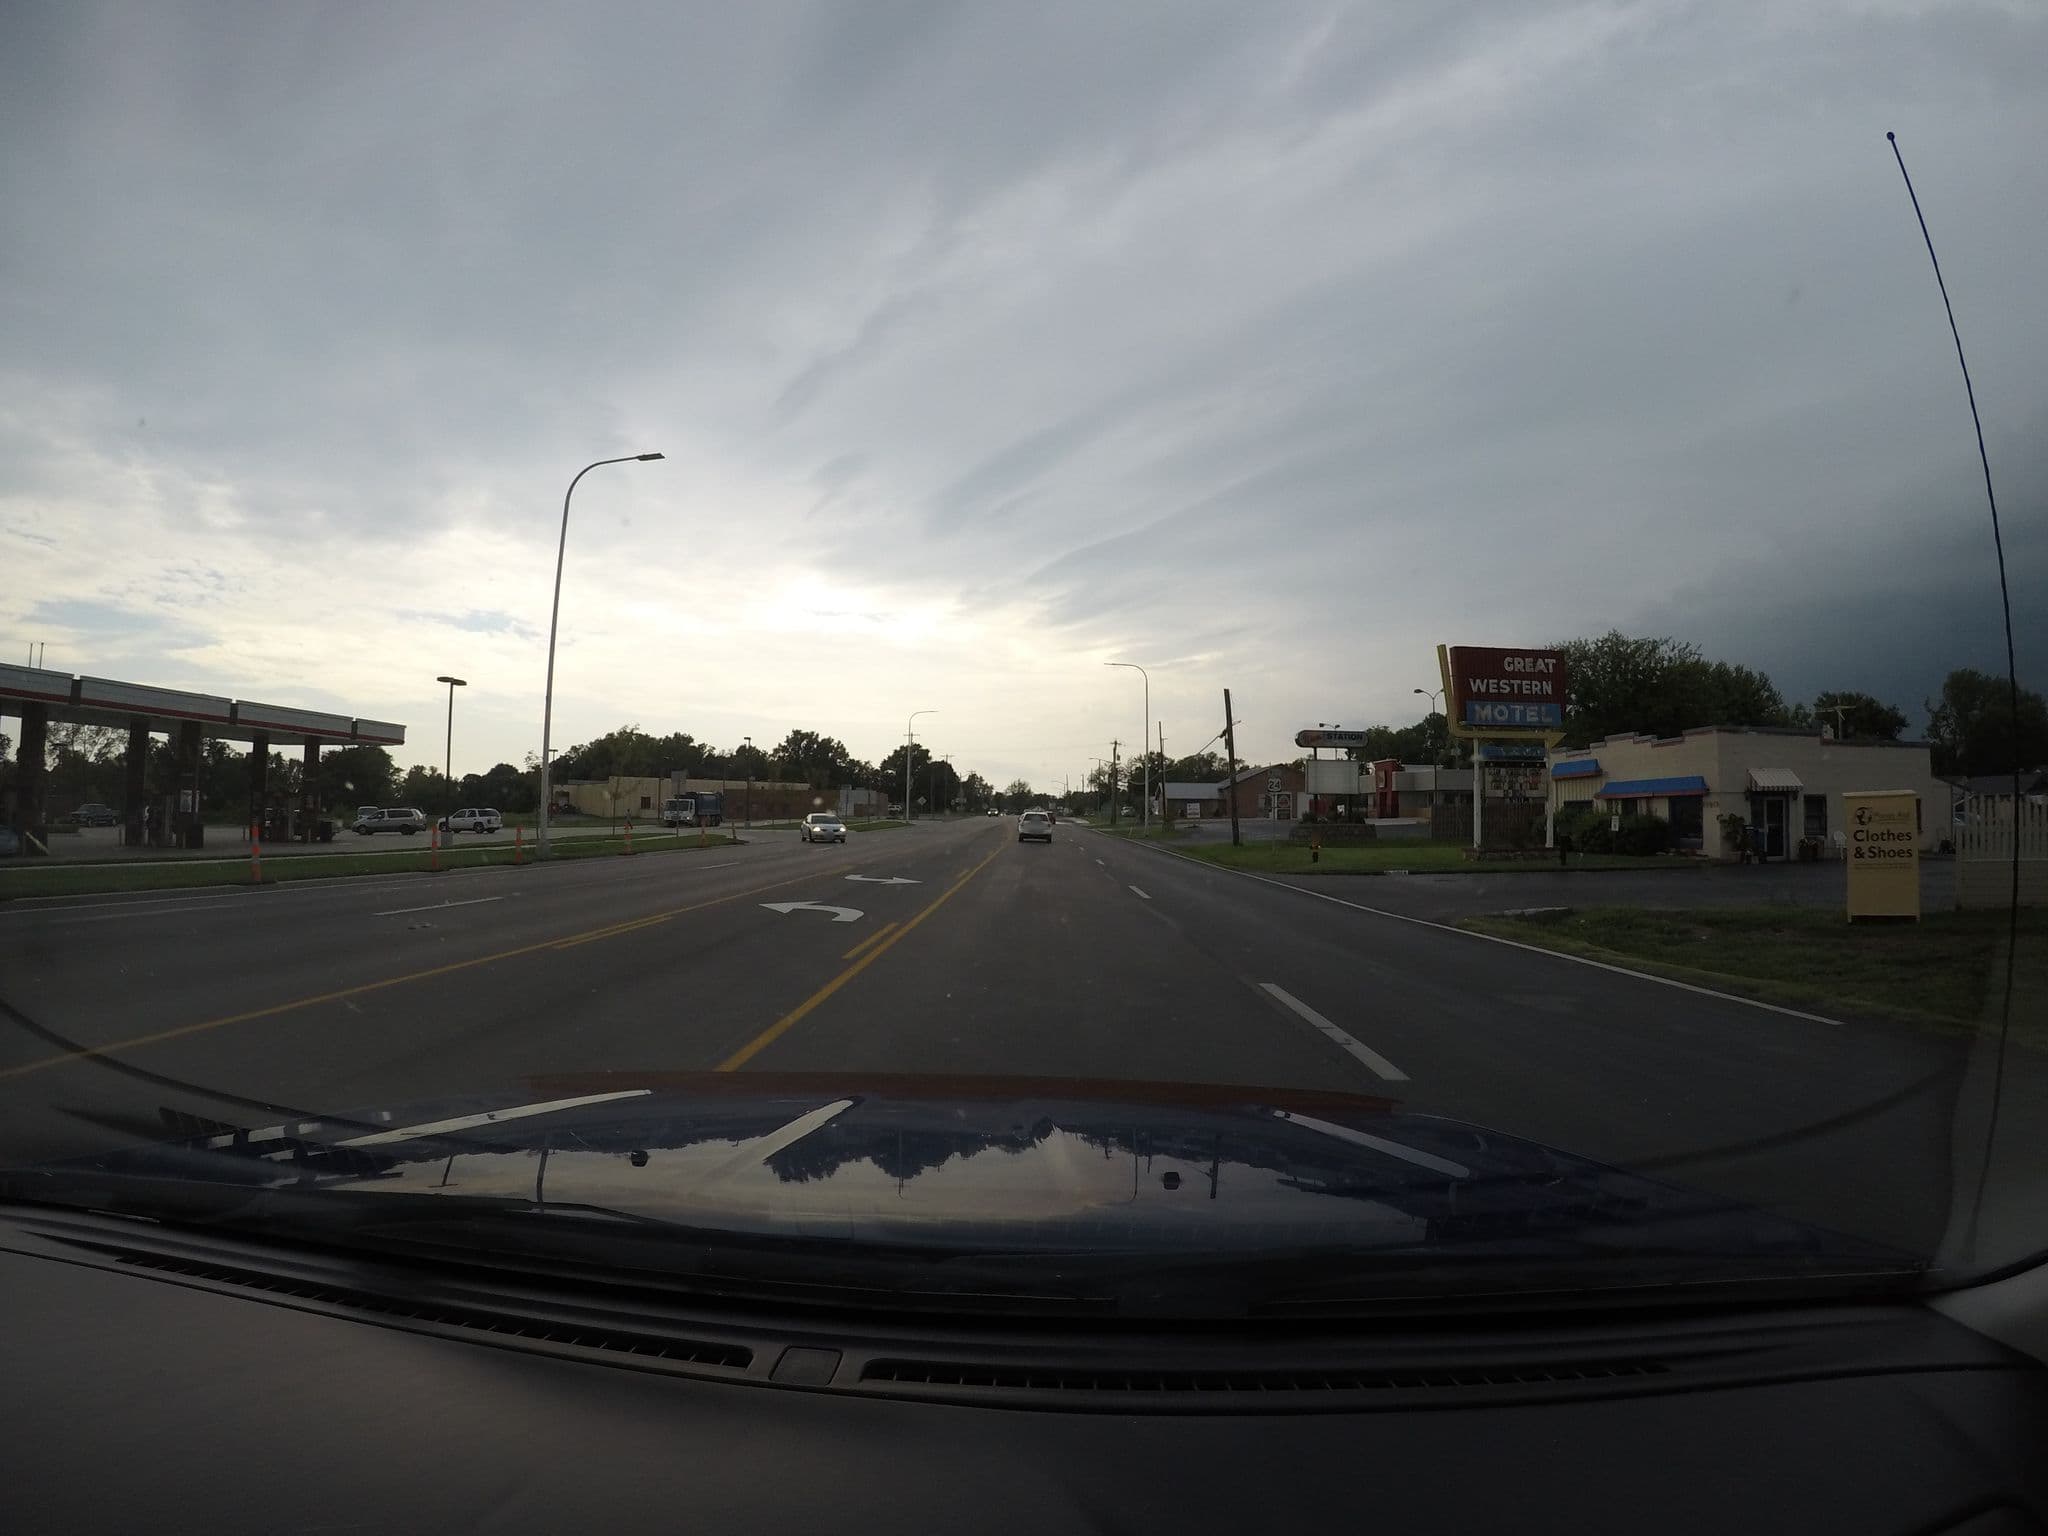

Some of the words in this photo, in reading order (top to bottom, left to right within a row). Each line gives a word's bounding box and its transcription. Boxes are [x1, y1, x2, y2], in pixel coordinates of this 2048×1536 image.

[1503, 656, 1556, 673] GREAT
[1469, 678, 1552, 695] WESTERN
[1475, 703, 1553, 722] MOTEL
[1326, 732, 1363, 741] STATION
[1269, 780, 1280, 790] 24
[1853, 828, 1912, 842] Clothes
[1853, 846, 1865, 859] &
[1868, 845, 1913, 859] Shoes
